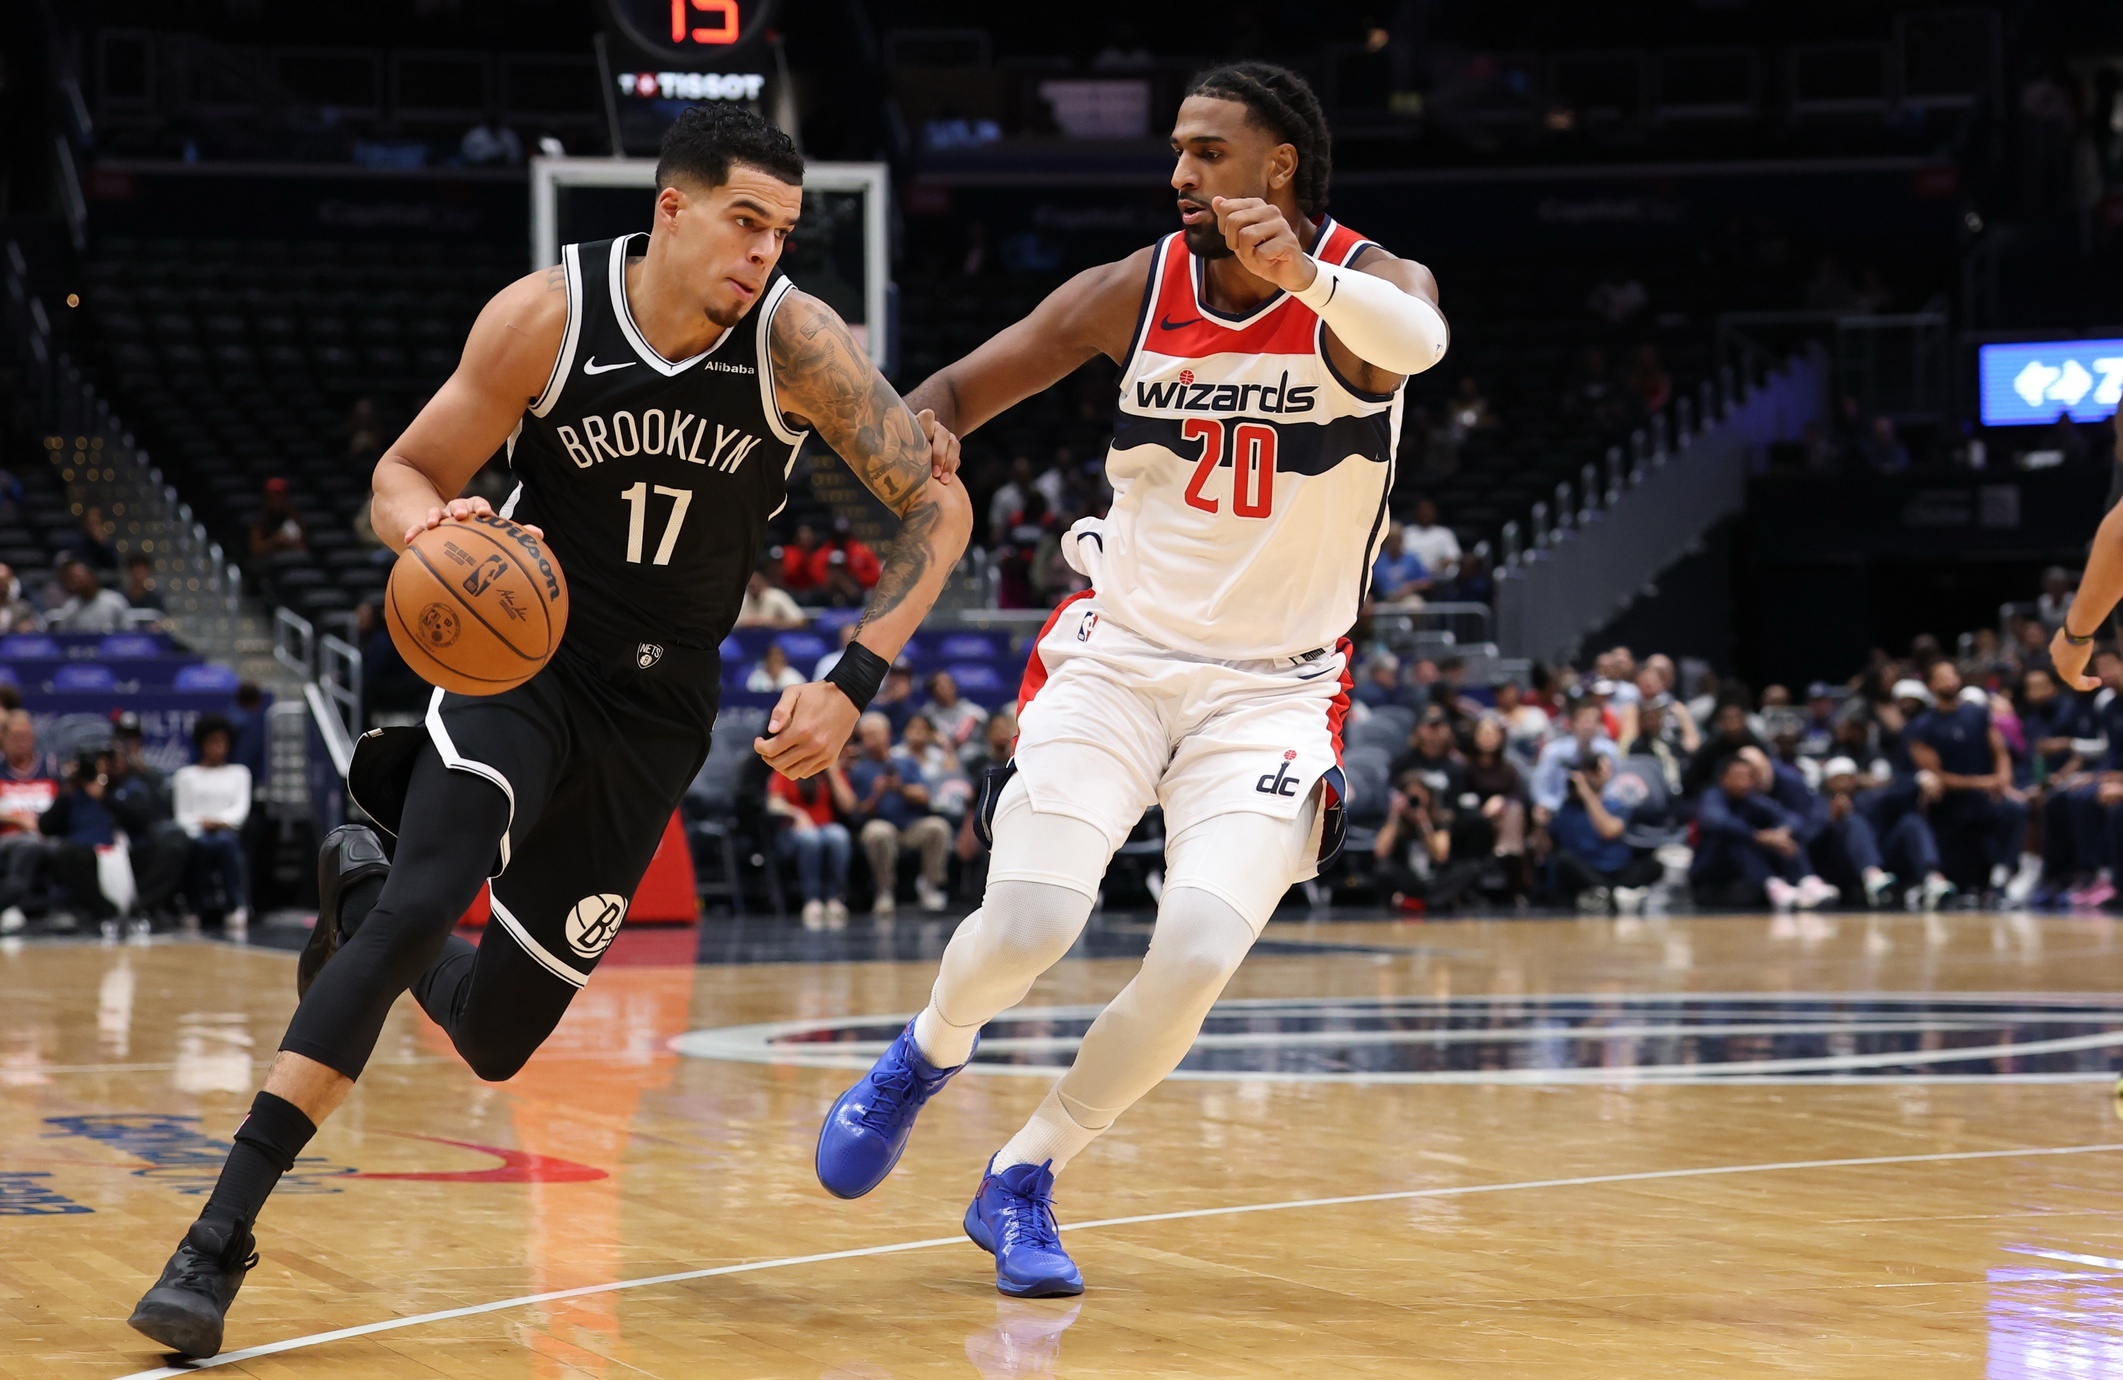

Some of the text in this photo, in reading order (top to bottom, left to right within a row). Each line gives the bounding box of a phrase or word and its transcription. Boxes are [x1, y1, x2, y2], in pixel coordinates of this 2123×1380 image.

[704, 360, 755, 375] Alibaba
[1136, 369, 1319, 414] wizards
[556, 408, 762, 474] BROOKLYN
[1183, 416, 1277, 519] 20
[620, 481, 693, 566] 17
[640, 643, 661, 658] NETS
[1255, 761, 1300, 797] dc
